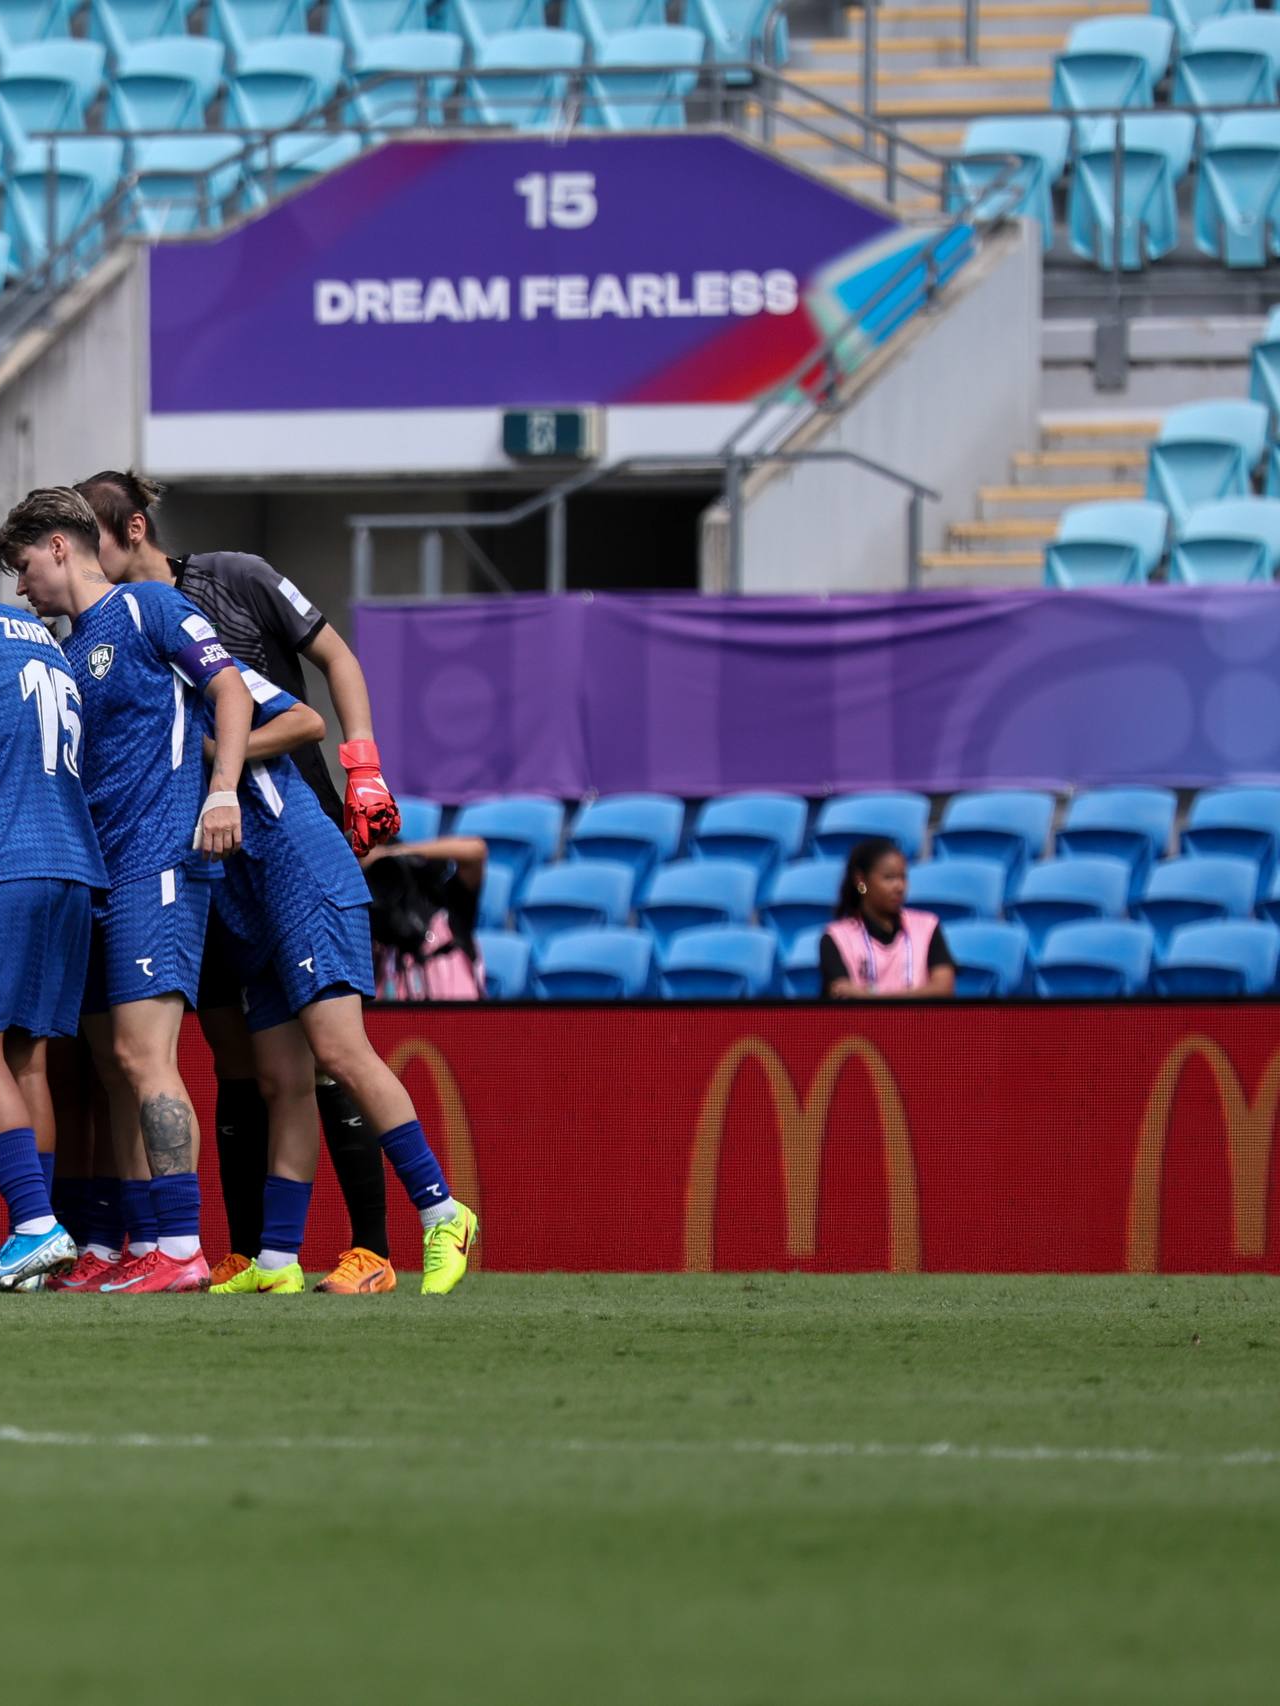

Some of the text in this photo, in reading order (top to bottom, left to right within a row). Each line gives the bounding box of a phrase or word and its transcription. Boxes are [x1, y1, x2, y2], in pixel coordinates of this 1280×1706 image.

[516, 172, 598, 229] 15
[315, 268, 799, 325] DREAM FEARLESS
[91, 650, 110, 665] UFA
[19, 658, 82, 778] 15
